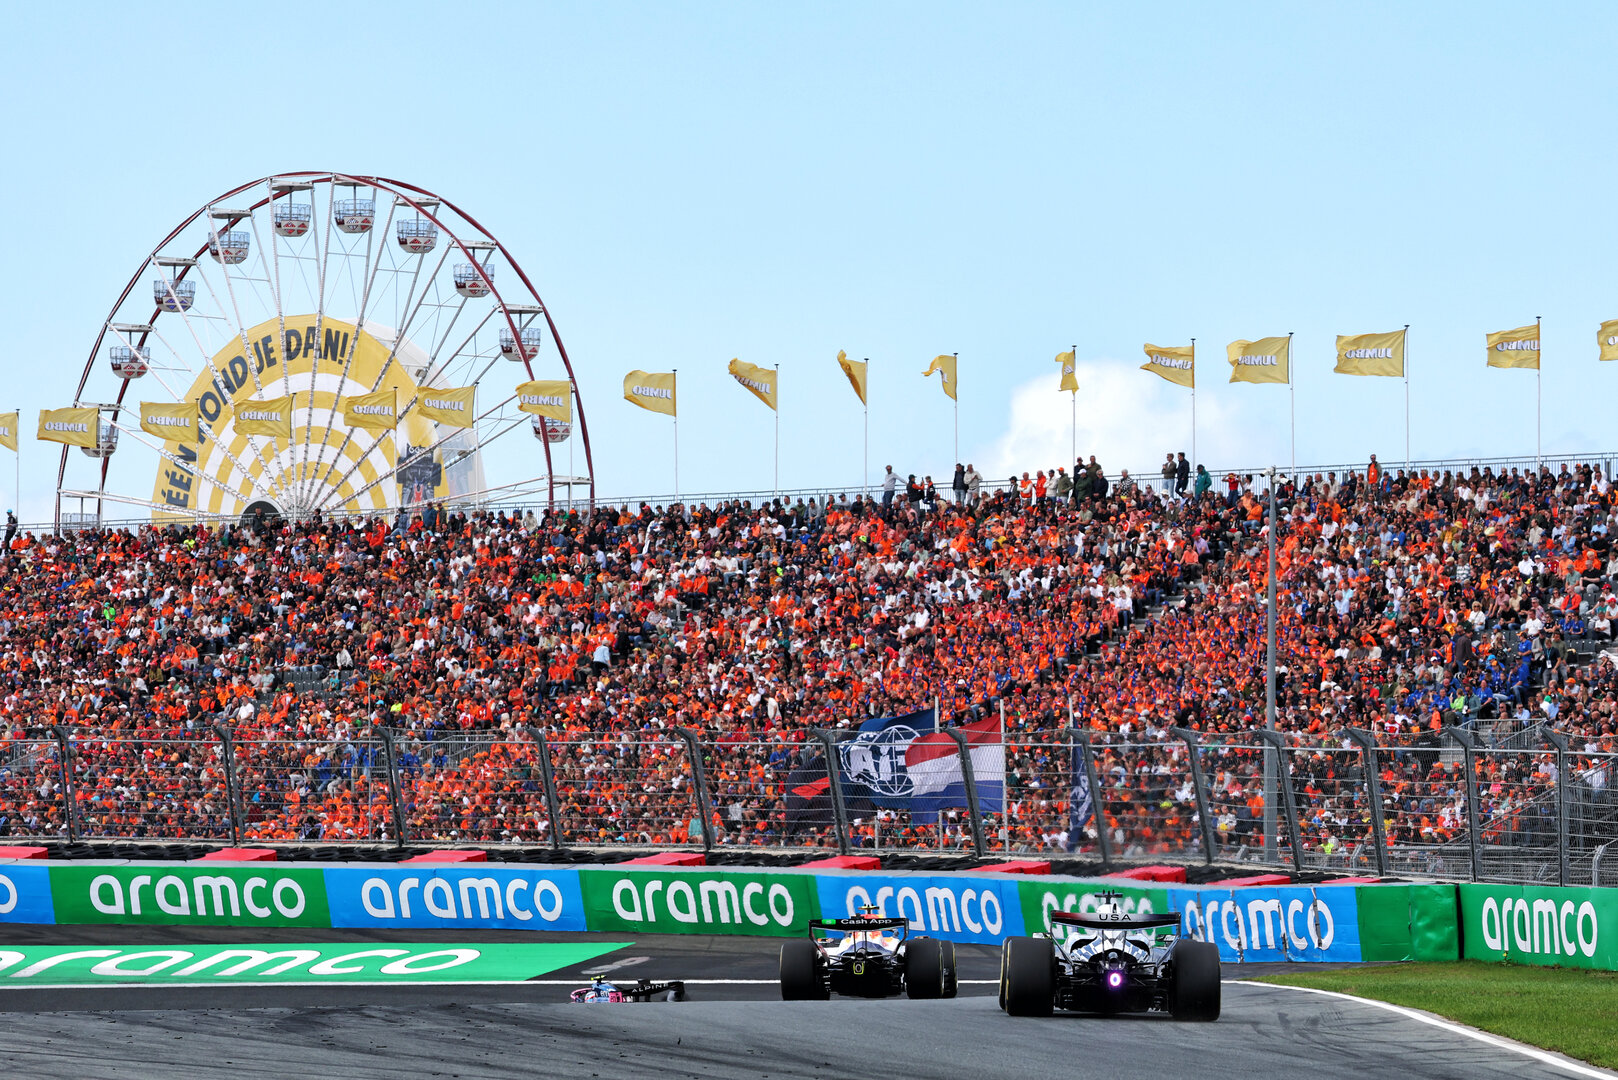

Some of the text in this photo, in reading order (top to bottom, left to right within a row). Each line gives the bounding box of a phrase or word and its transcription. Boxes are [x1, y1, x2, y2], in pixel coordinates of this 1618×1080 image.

[285, 326, 349, 366] DAN!
[89, 874, 306, 918] aramco
[361, 877, 563, 922] aramco
[612, 878, 794, 927] aramco
[846, 885, 1002, 935] aramco
[1098, 913, 1132, 921] USA
[1185, 898, 1335, 950] aramco
[1481, 896, 1599, 958] aramco
